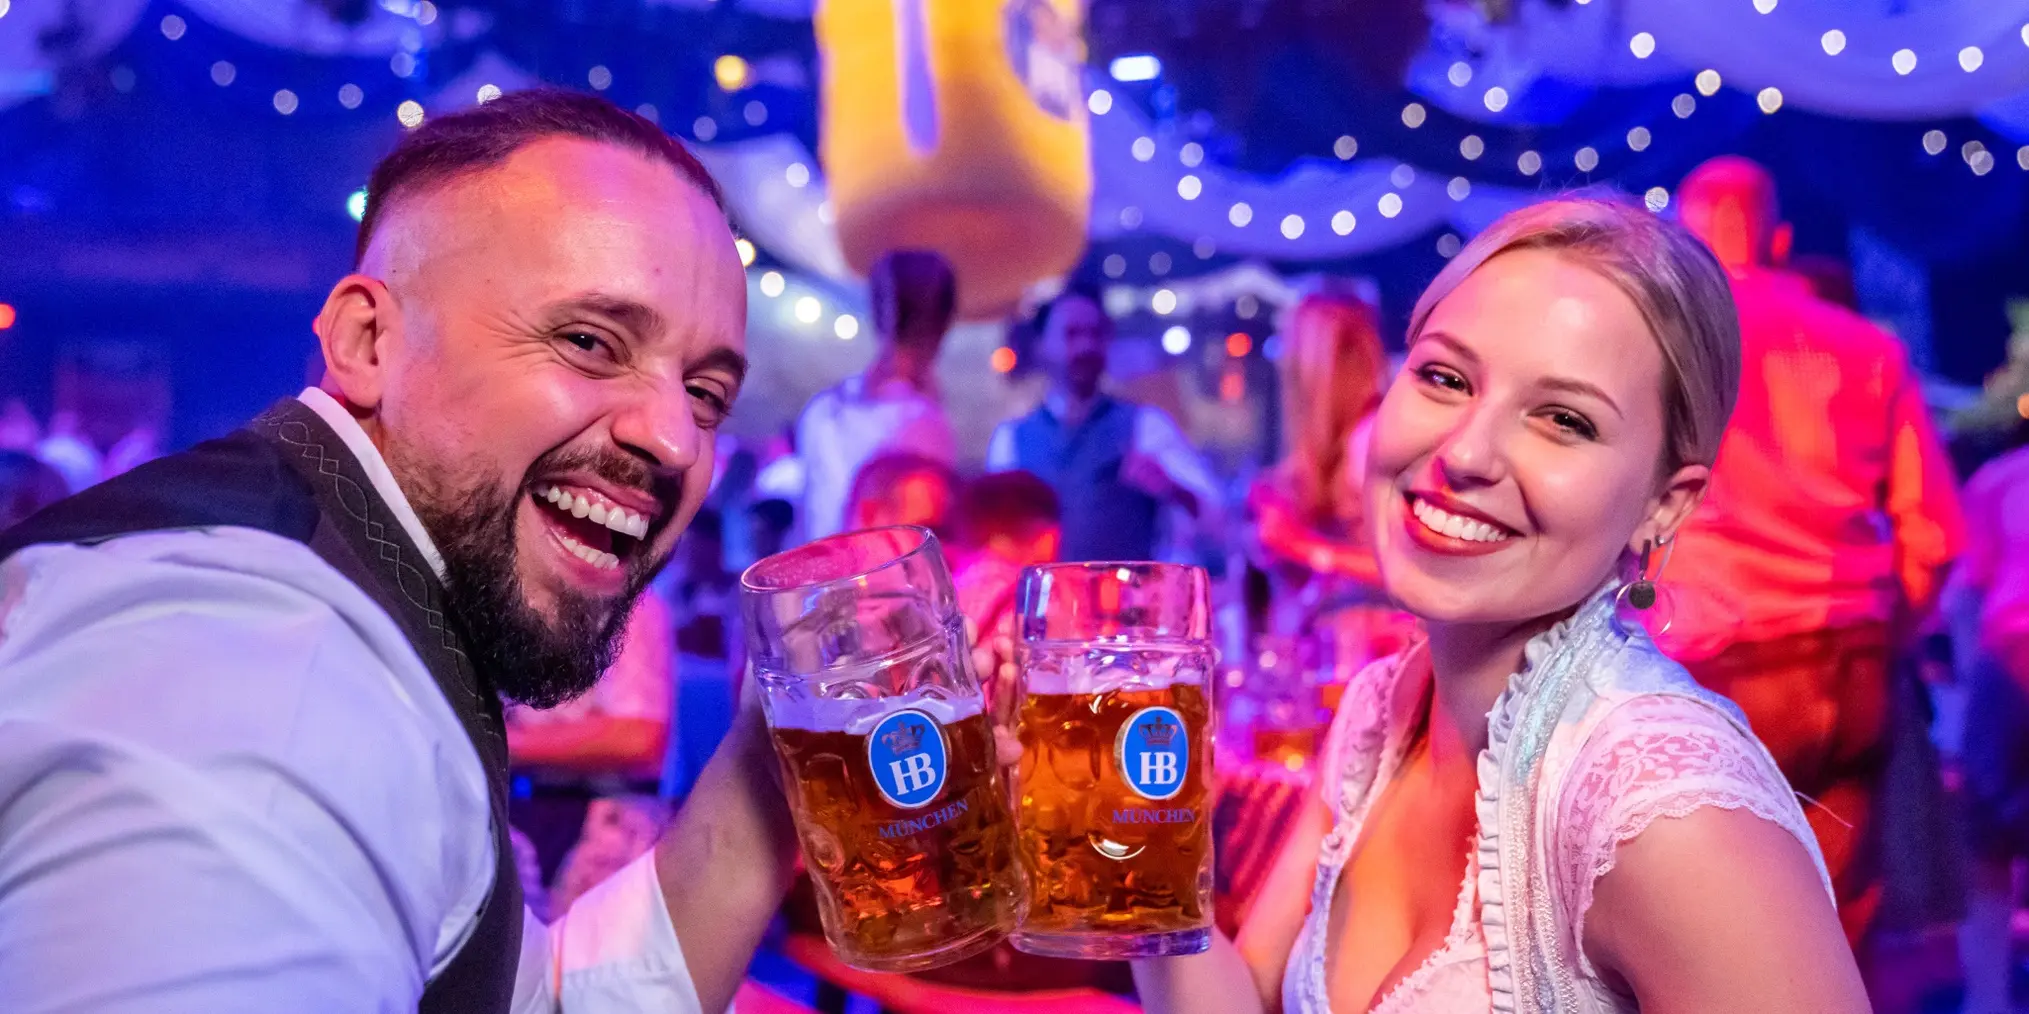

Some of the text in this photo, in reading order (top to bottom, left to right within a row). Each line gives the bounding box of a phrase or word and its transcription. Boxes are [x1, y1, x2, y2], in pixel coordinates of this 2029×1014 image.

[889, 752, 936, 796] HB
[1139, 751, 1178, 785] HB
[878, 799, 969, 838] MÜNCHEN
